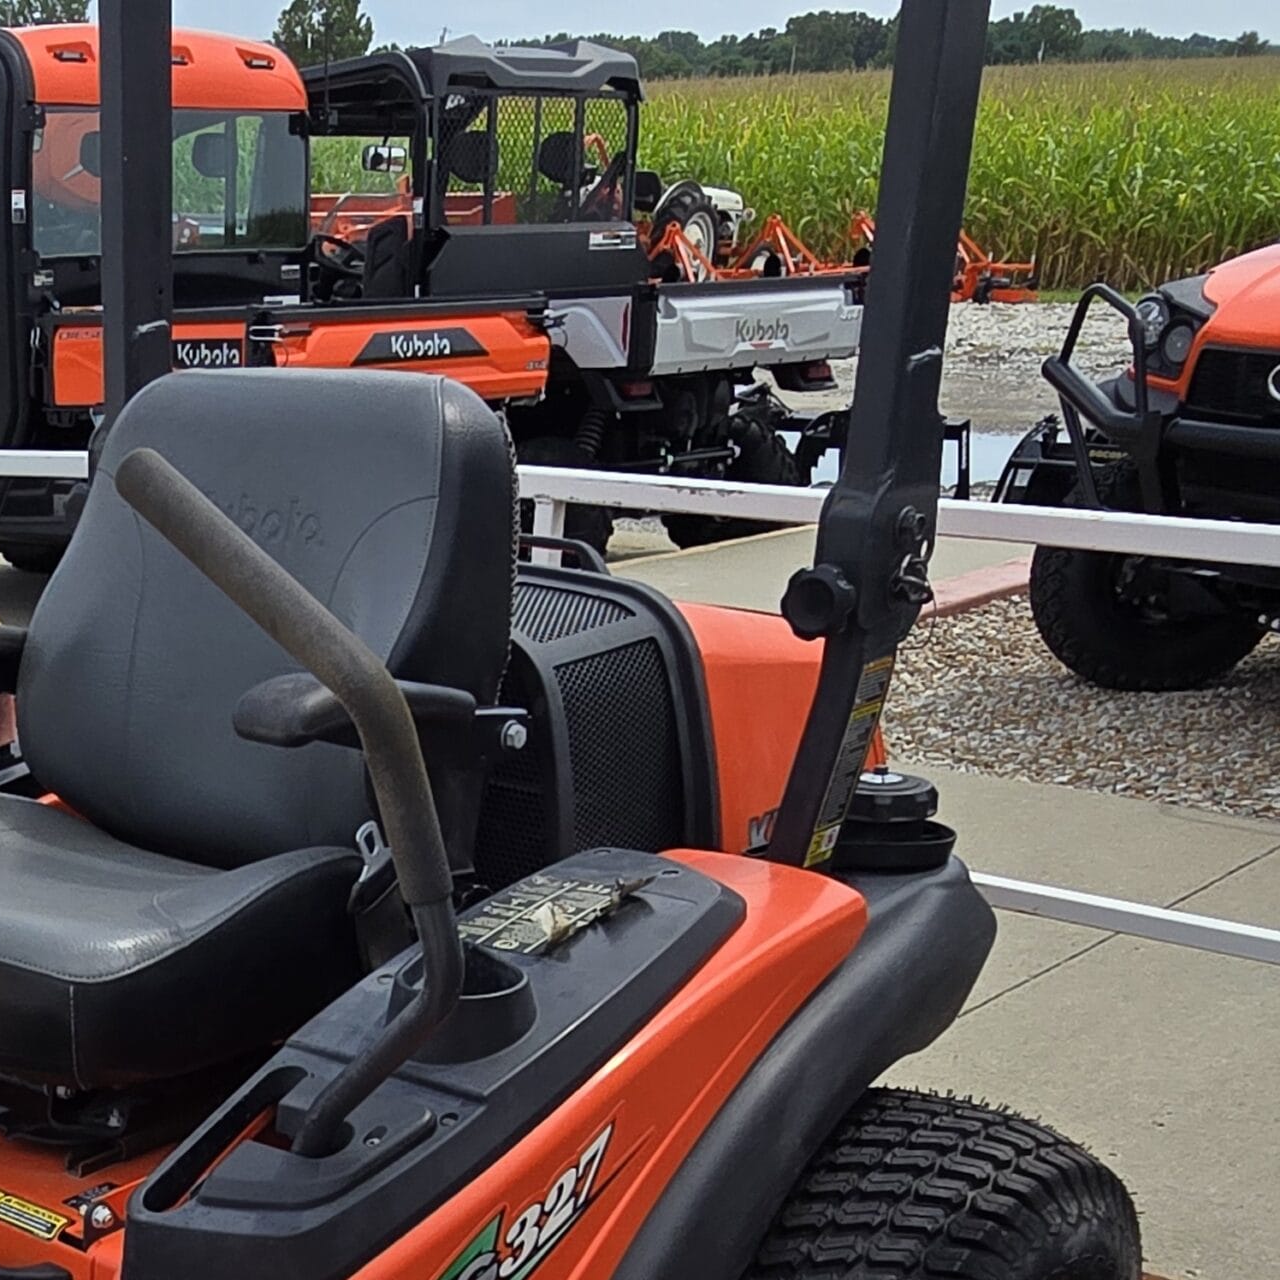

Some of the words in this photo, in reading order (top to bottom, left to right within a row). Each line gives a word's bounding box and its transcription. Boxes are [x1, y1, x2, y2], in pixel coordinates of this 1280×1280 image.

[736, 318, 789, 341] Kubota
[176, 342, 240, 367] Kubota
[391, 332, 451, 359] Kubota
